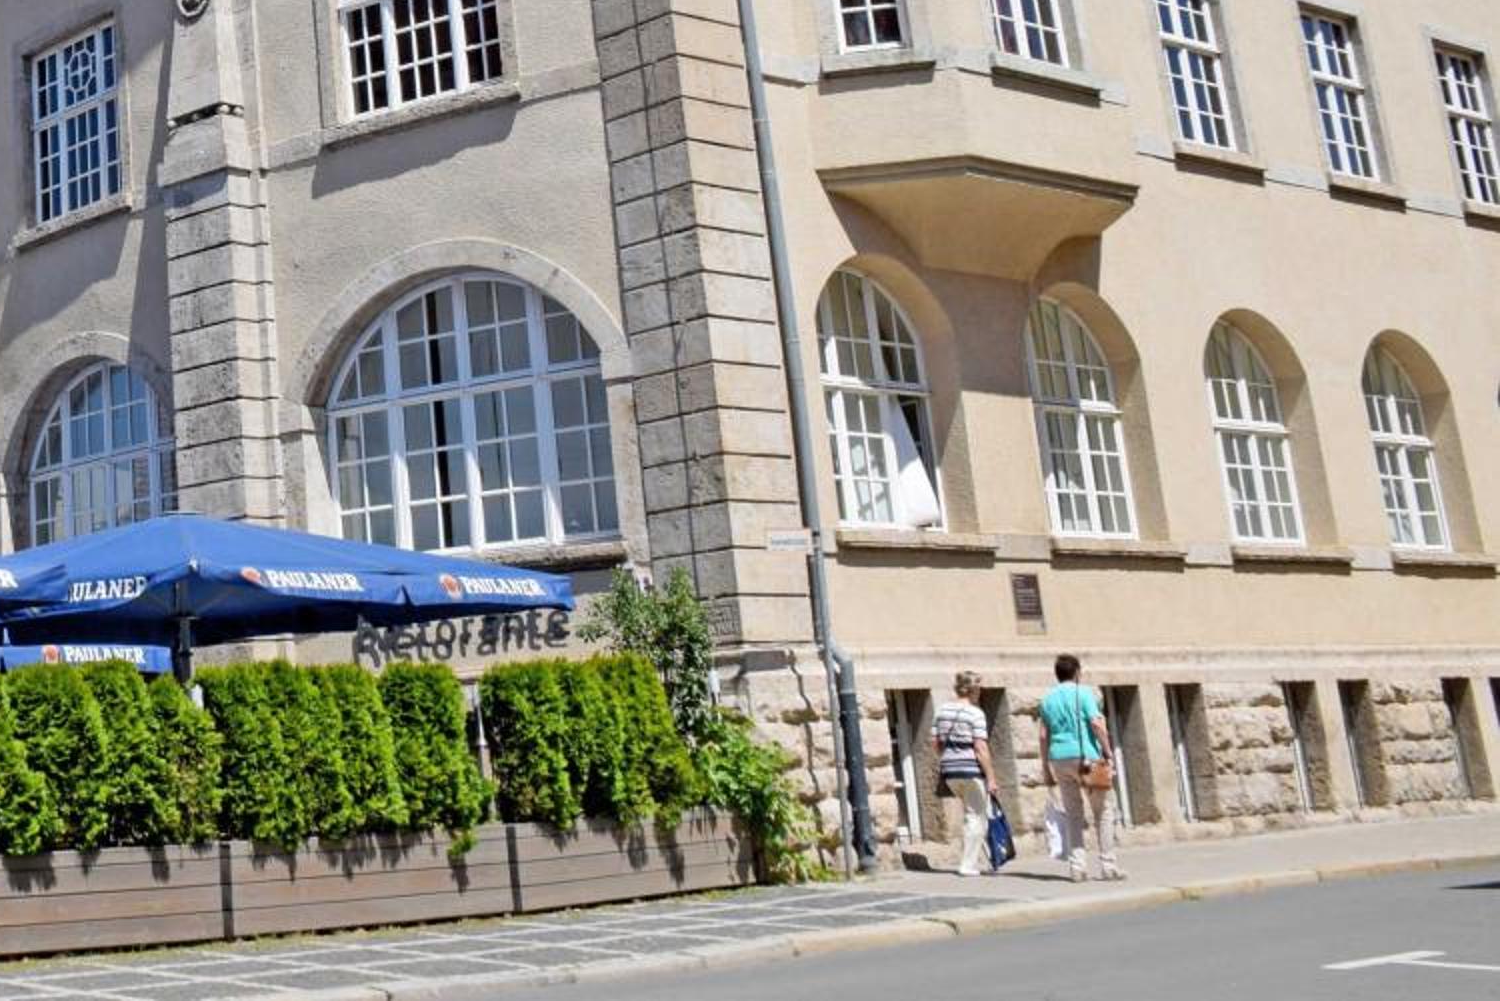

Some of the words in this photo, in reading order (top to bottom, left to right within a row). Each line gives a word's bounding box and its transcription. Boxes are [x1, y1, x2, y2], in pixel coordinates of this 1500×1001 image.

[70, 576, 146, 602] ULANER
[265, 570, 363, 592] PAULANER
[462, 576, 546, 596] PAULANER
[64, 646, 146, 663] PAULANER
